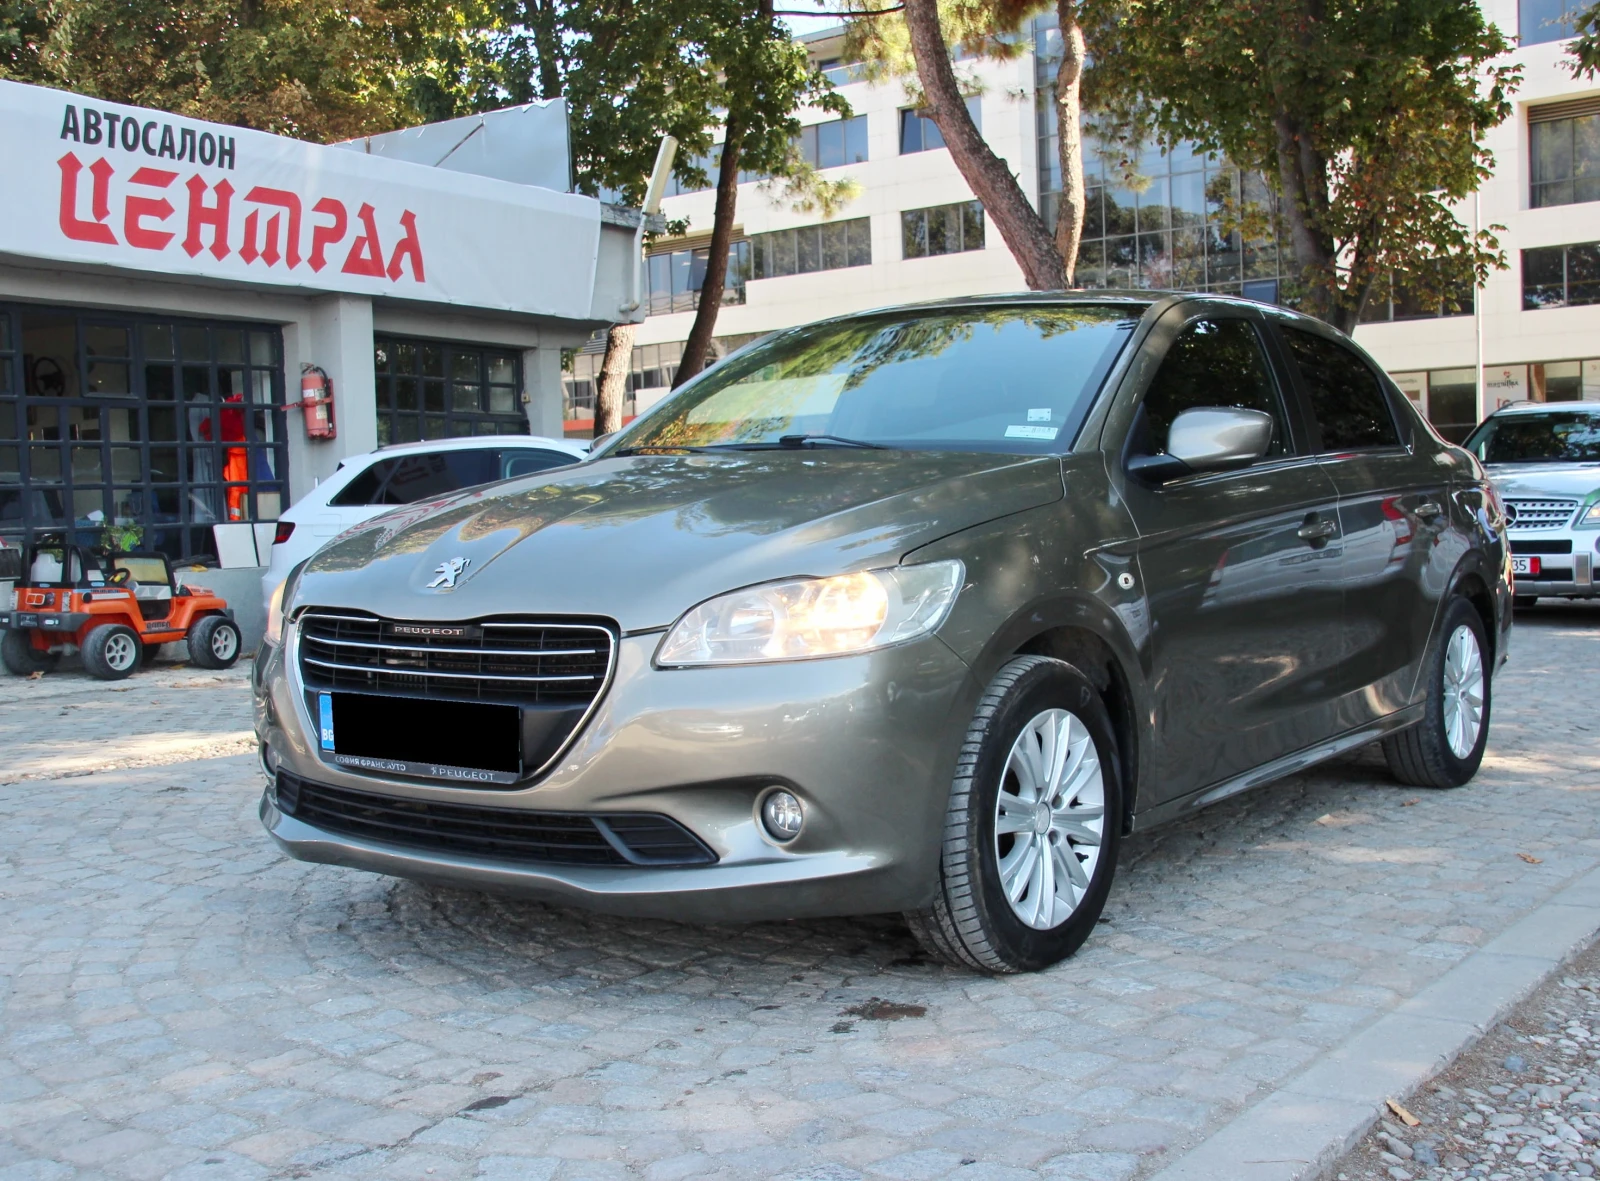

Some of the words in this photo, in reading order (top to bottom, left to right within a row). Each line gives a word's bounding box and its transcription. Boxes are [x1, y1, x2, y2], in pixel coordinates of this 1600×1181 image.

[61, 104, 235, 169] АВТОСАЛОН
[57, 151, 425, 283] ЦЕНТРАЛ
[394, 626, 464, 635] PEUGEOT
[322, 728, 334, 741] BG
[439, 768, 495, 781] PEUGEOT
